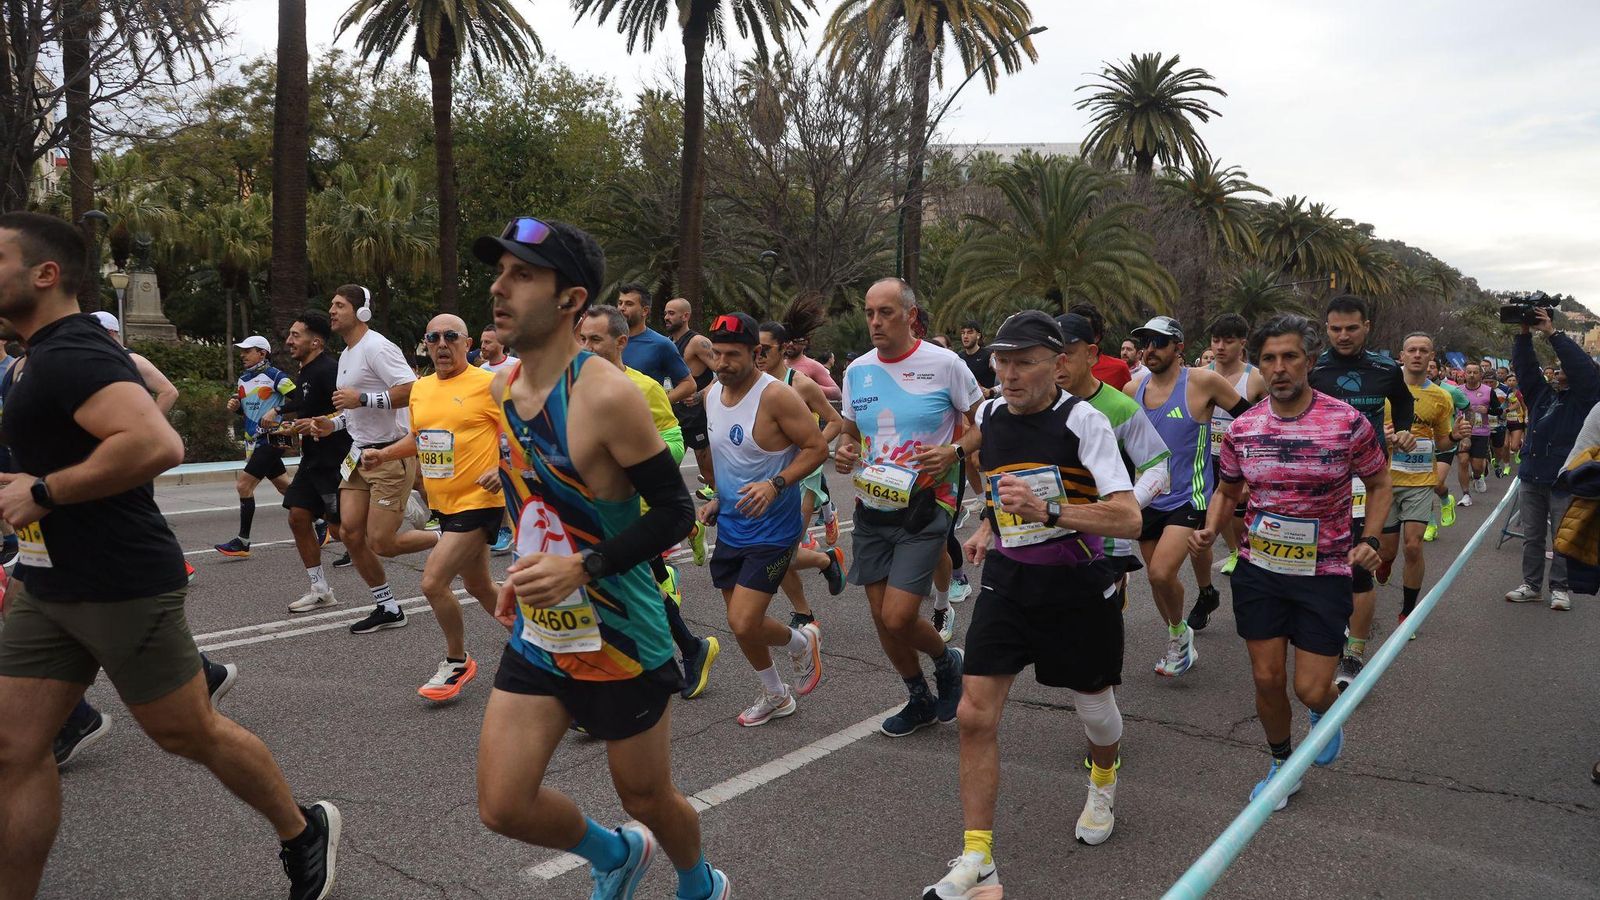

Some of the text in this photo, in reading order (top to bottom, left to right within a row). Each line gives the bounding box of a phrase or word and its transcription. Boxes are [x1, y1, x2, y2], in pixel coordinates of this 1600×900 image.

[852, 396, 879, 405] Málaga
[421, 452, 444, 465] 1981
[1405, 454, 1424, 464] 238
[865, 482, 899, 502] 1643
[1262, 540, 1305, 560] 2773
